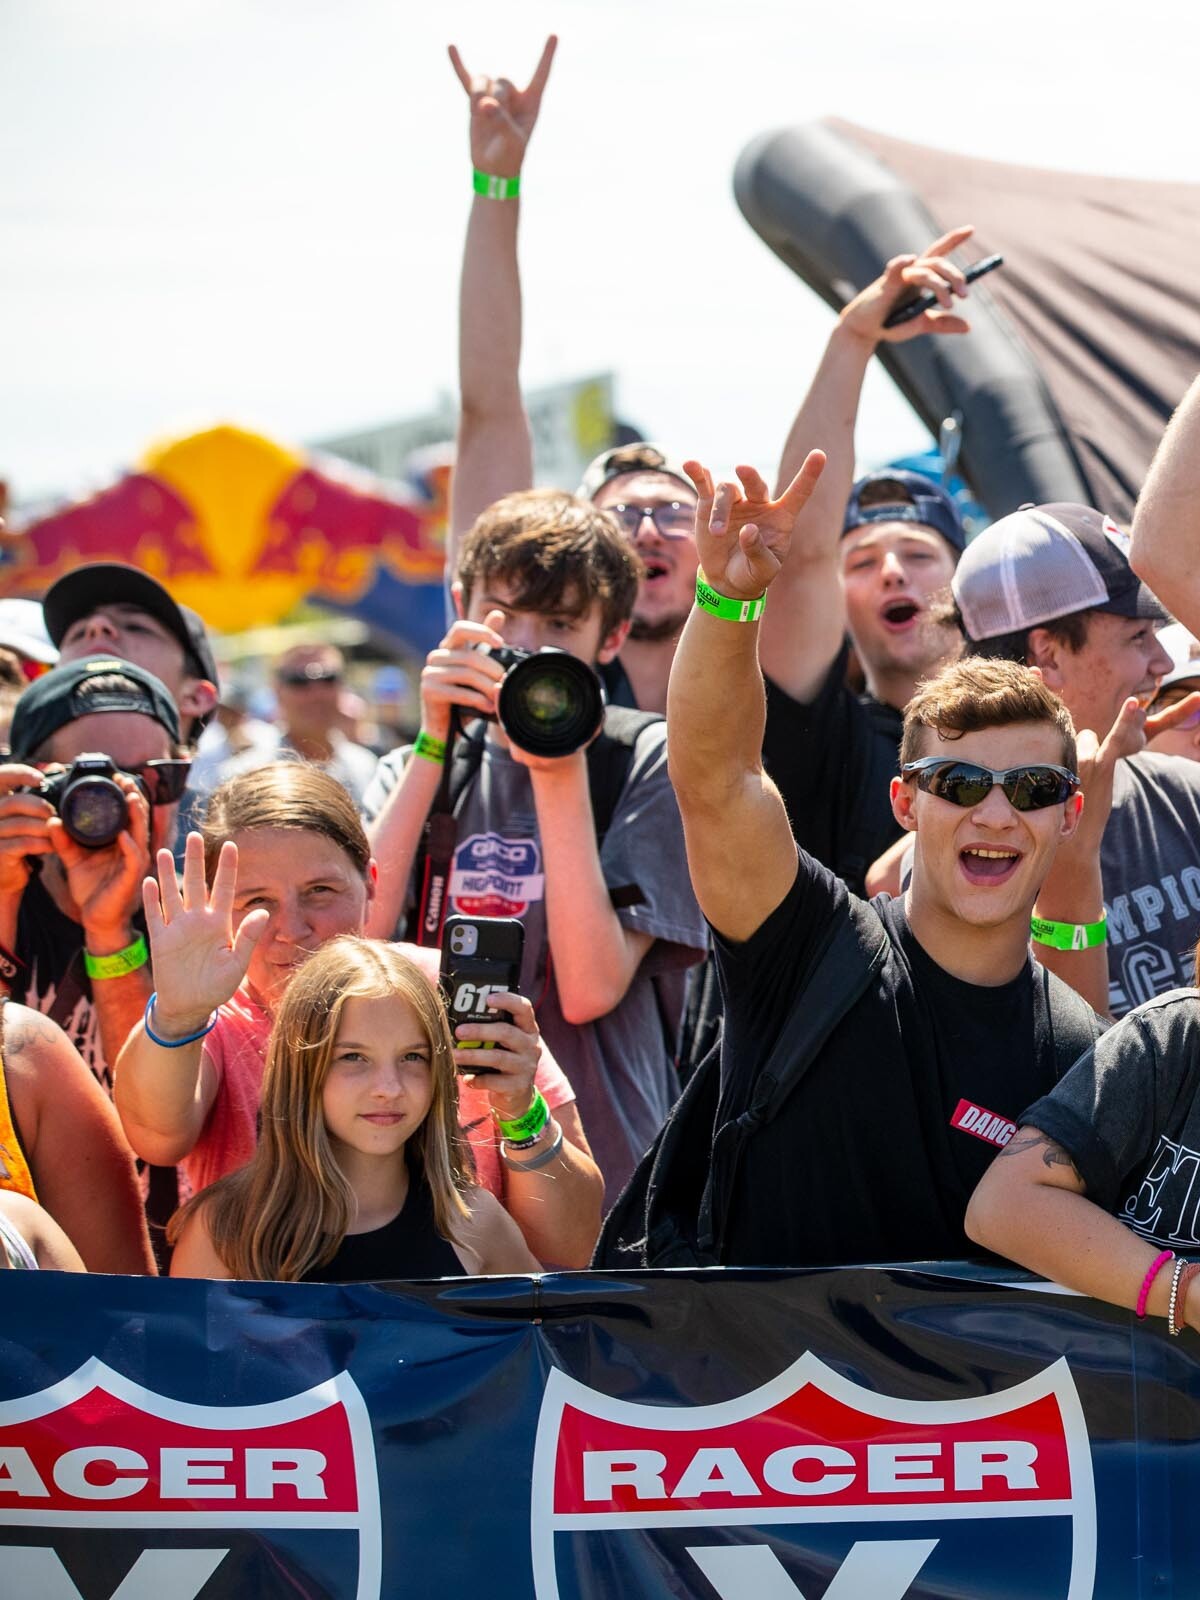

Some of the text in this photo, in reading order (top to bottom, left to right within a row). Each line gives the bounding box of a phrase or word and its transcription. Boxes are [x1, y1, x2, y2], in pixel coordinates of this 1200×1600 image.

[425, 876, 445, 932] Canon
[957, 1106, 1017, 1146] DANG
[582, 1440, 1041, 1502] RACER
